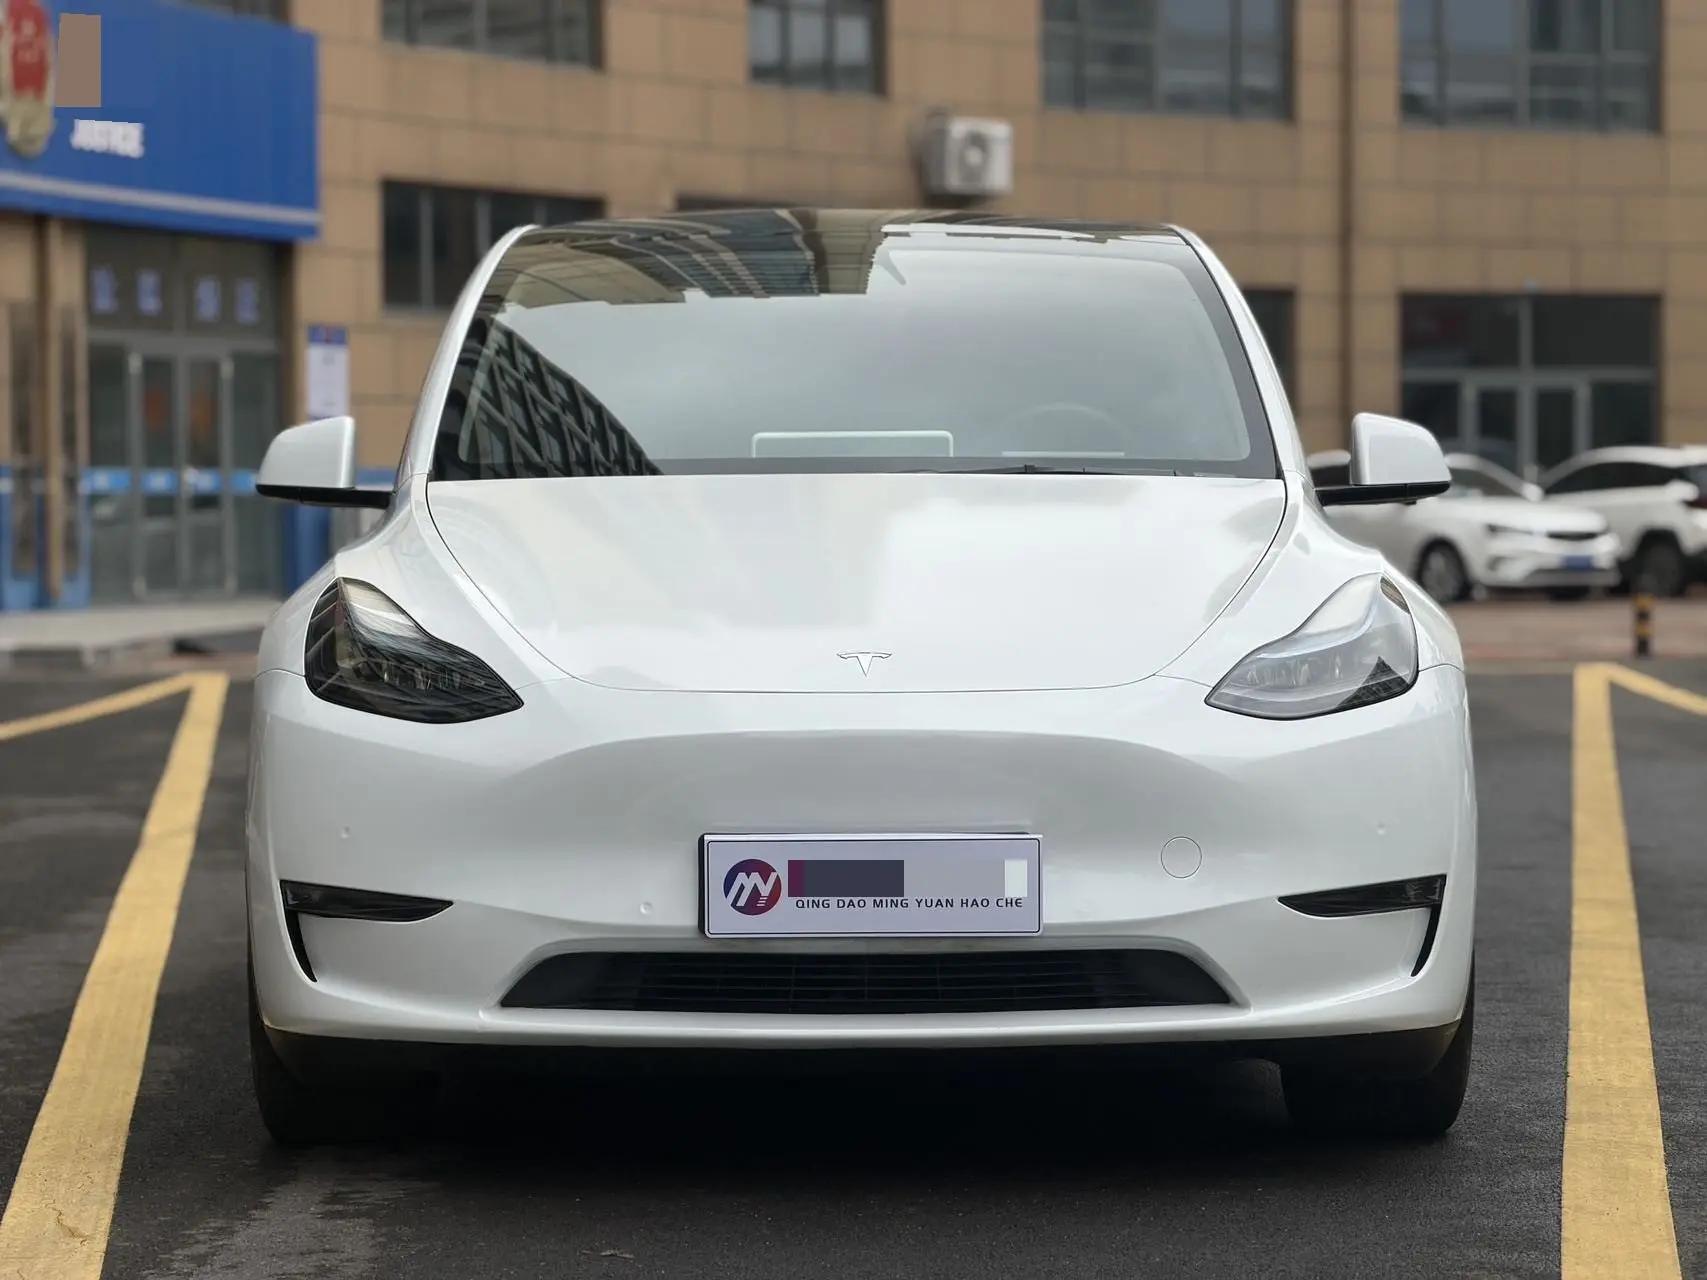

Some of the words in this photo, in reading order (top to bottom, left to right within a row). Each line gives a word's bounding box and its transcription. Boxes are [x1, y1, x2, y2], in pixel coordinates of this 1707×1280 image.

[795, 898, 831, 909] QING
[836, 898, 867, 909] DAO
[872, 898, 909, 909] MING
[915, 897, 954, 908] YUAN
[960, 897, 990, 908] HAO
[995, 897, 1023, 908] CHE
